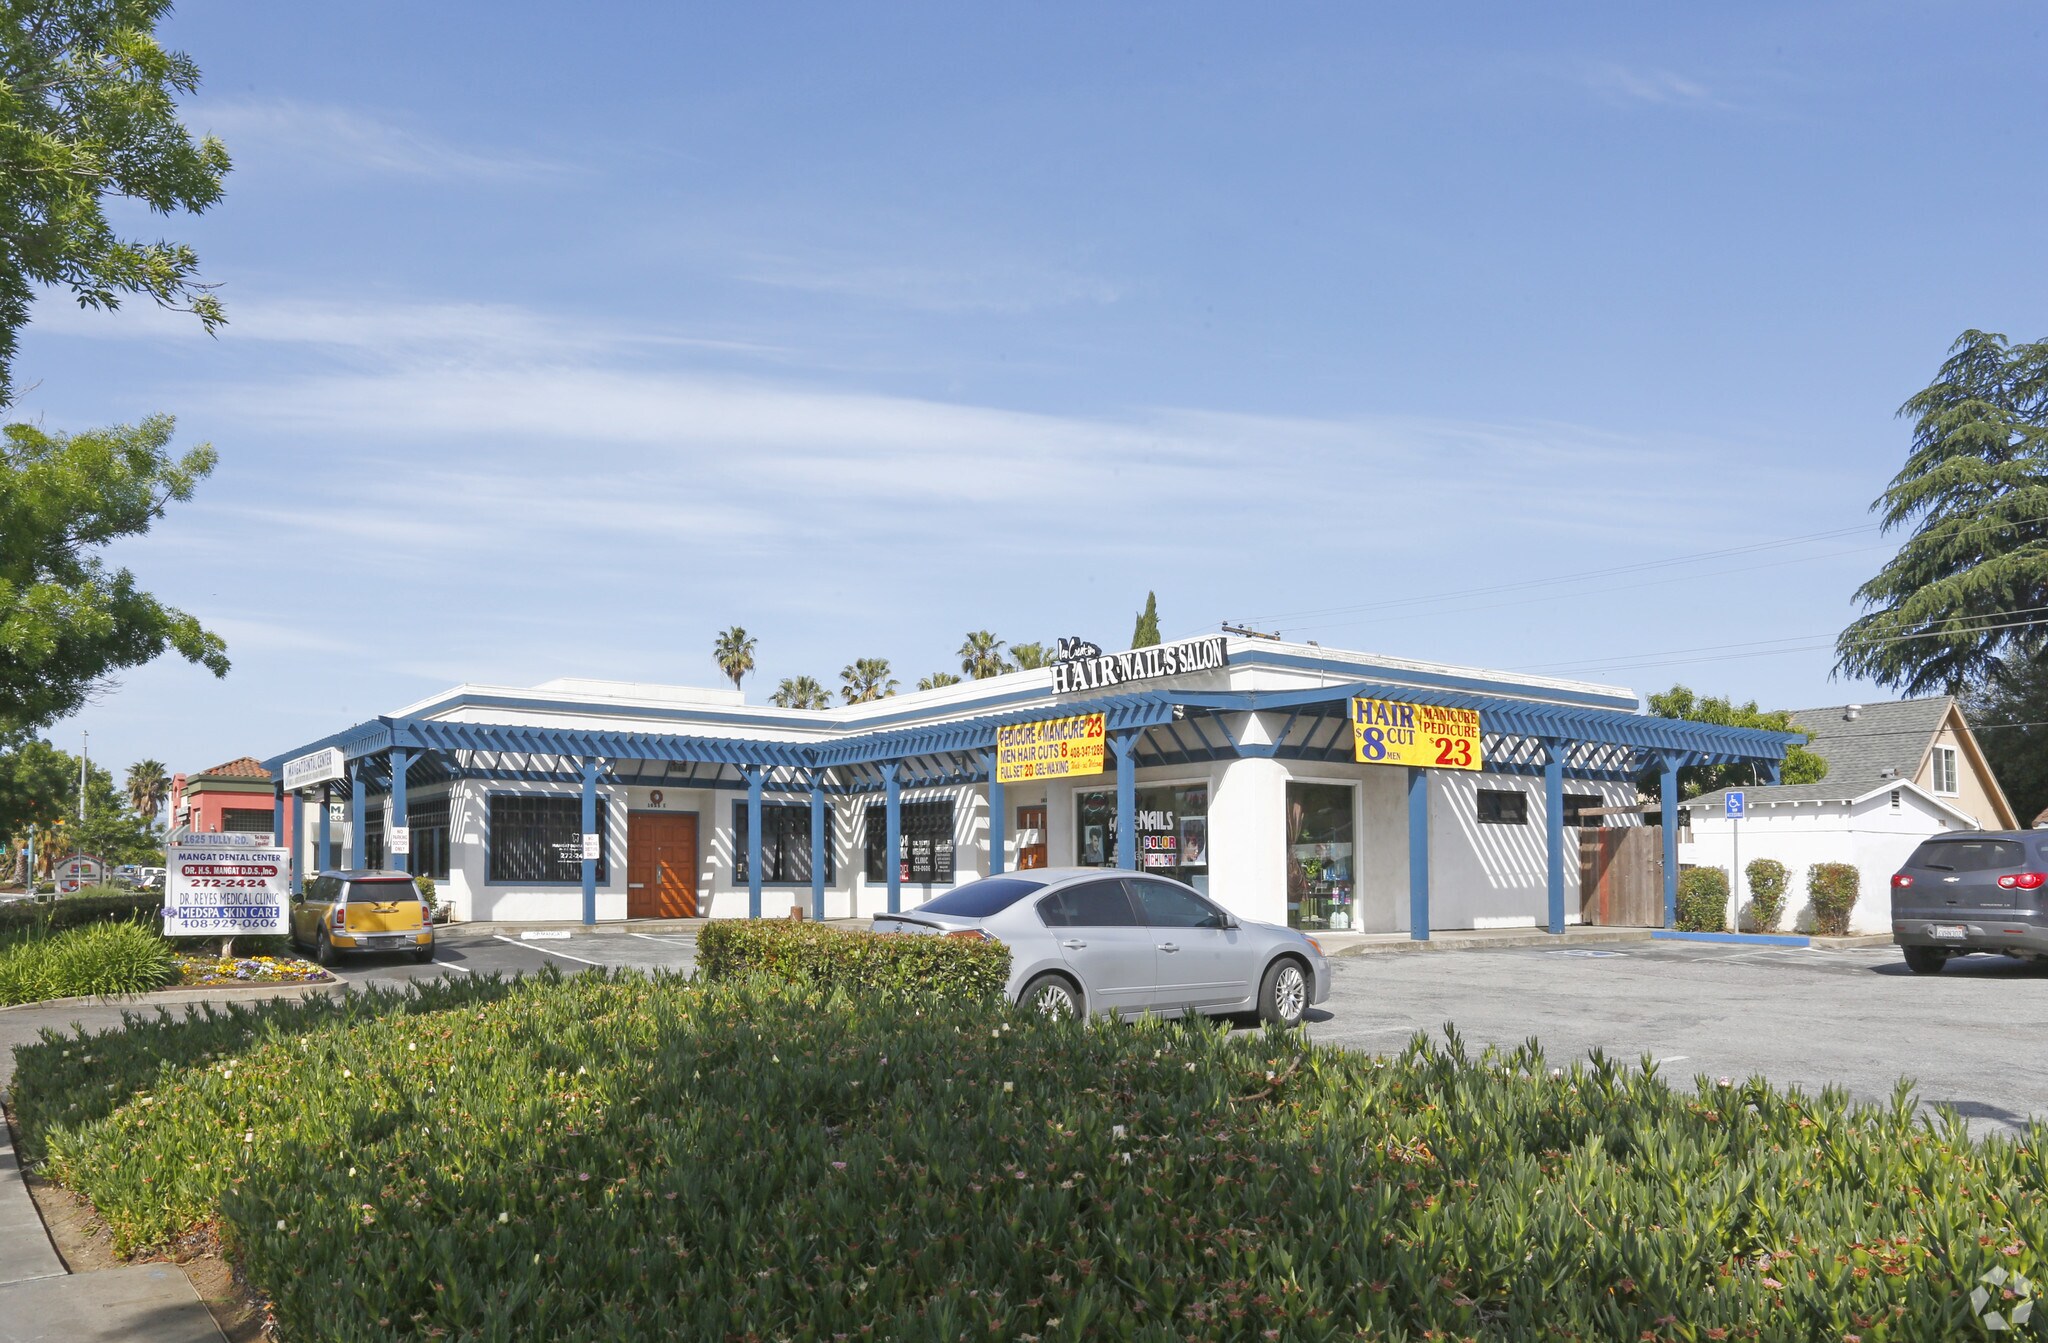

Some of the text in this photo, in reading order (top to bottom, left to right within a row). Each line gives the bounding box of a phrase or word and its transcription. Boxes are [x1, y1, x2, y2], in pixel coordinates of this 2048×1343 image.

[1051, 638, 1224, 694] HAIR NAILS SALON
[1356, 700, 1415, 728] HAIR
[1423, 707, 1477, 725] MANICURE
[1000, 727, 1036, 747] PEDICURE
[1042, 720, 1085, 742] MANICURE
[1386, 728, 1415, 745] CUT
[1423, 722, 1477, 738] PEDICURE
[1000, 748, 1017, 764] MEN
[1017, 746, 1037, 762] HAIR
[1037, 744, 1059, 759] CUTS
[1387, 751, 1401, 760] MEN
[1429, 737, 1472, 767] $23
[1000, 765, 1013, 779] FULL
[1013, 764, 1023, 778] SET
[1139, 810, 1174, 831] NAILS
[185, 835, 249, 845] 1625 TULLY RD.
[1144, 835, 1177, 849] COLOR
[178, 853, 281, 862] MANGAT DENTAL CENTER
[1144, 853, 1177, 867] HIGHLIGHT
[185, 867, 197, 875] DR.
[198, 867, 212, 875] H.S.
[213, 867, 240, 875] MANGAT
[191, 879, 267, 888] 272-2424
[180, 893, 279, 905] DR. REYES MEDICAL CLINIC
[180, 907, 278, 918] MEDSPA SKIN CARE
[180, 919, 278, 928] 408-929-0606
